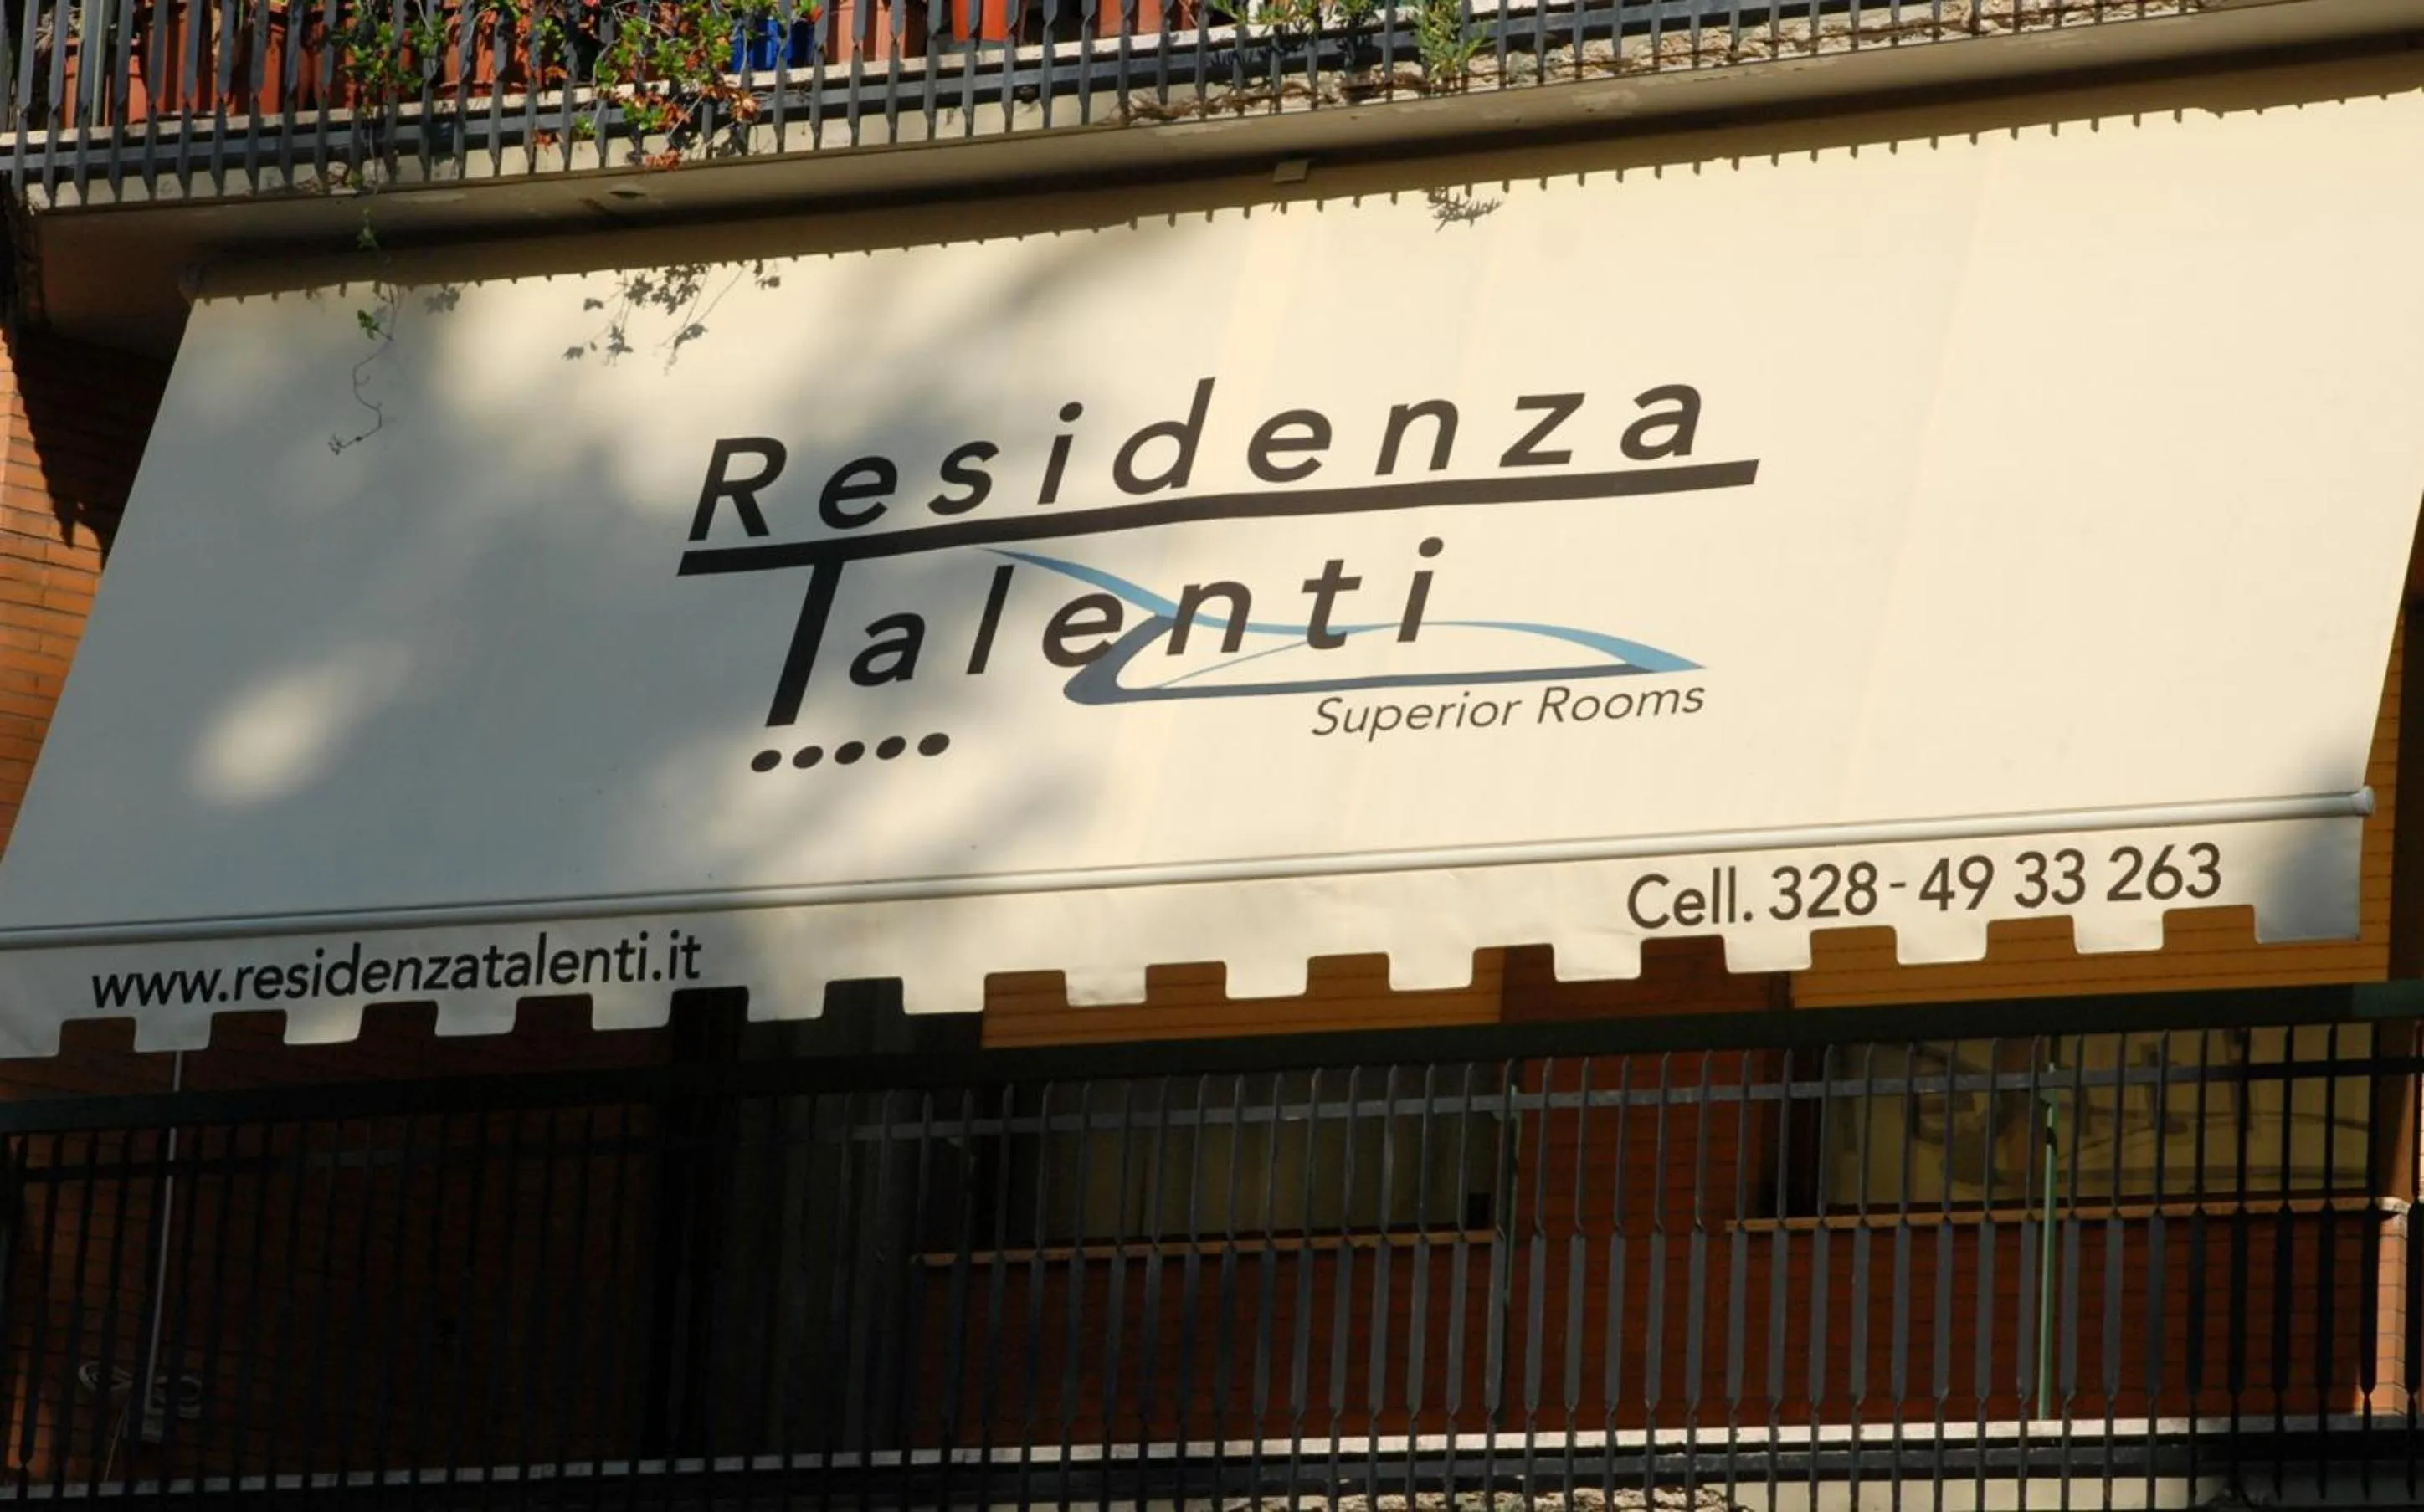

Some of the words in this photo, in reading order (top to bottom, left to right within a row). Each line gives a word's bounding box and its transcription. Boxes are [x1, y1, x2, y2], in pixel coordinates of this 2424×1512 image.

[686, 377, 1702, 543] Residenza
[766, 537, 1443, 728] Talenti
[1312, 691, 1523, 743] Superior
[1537, 684, 1706, 725] Rooms
[1626, 866, 1754, 930] Cell.
[2013, 848, 2087, 909] 33
[2105, 841, 2222, 903] 263
[92, 930, 702, 1009] www.residenzatalenti.it
